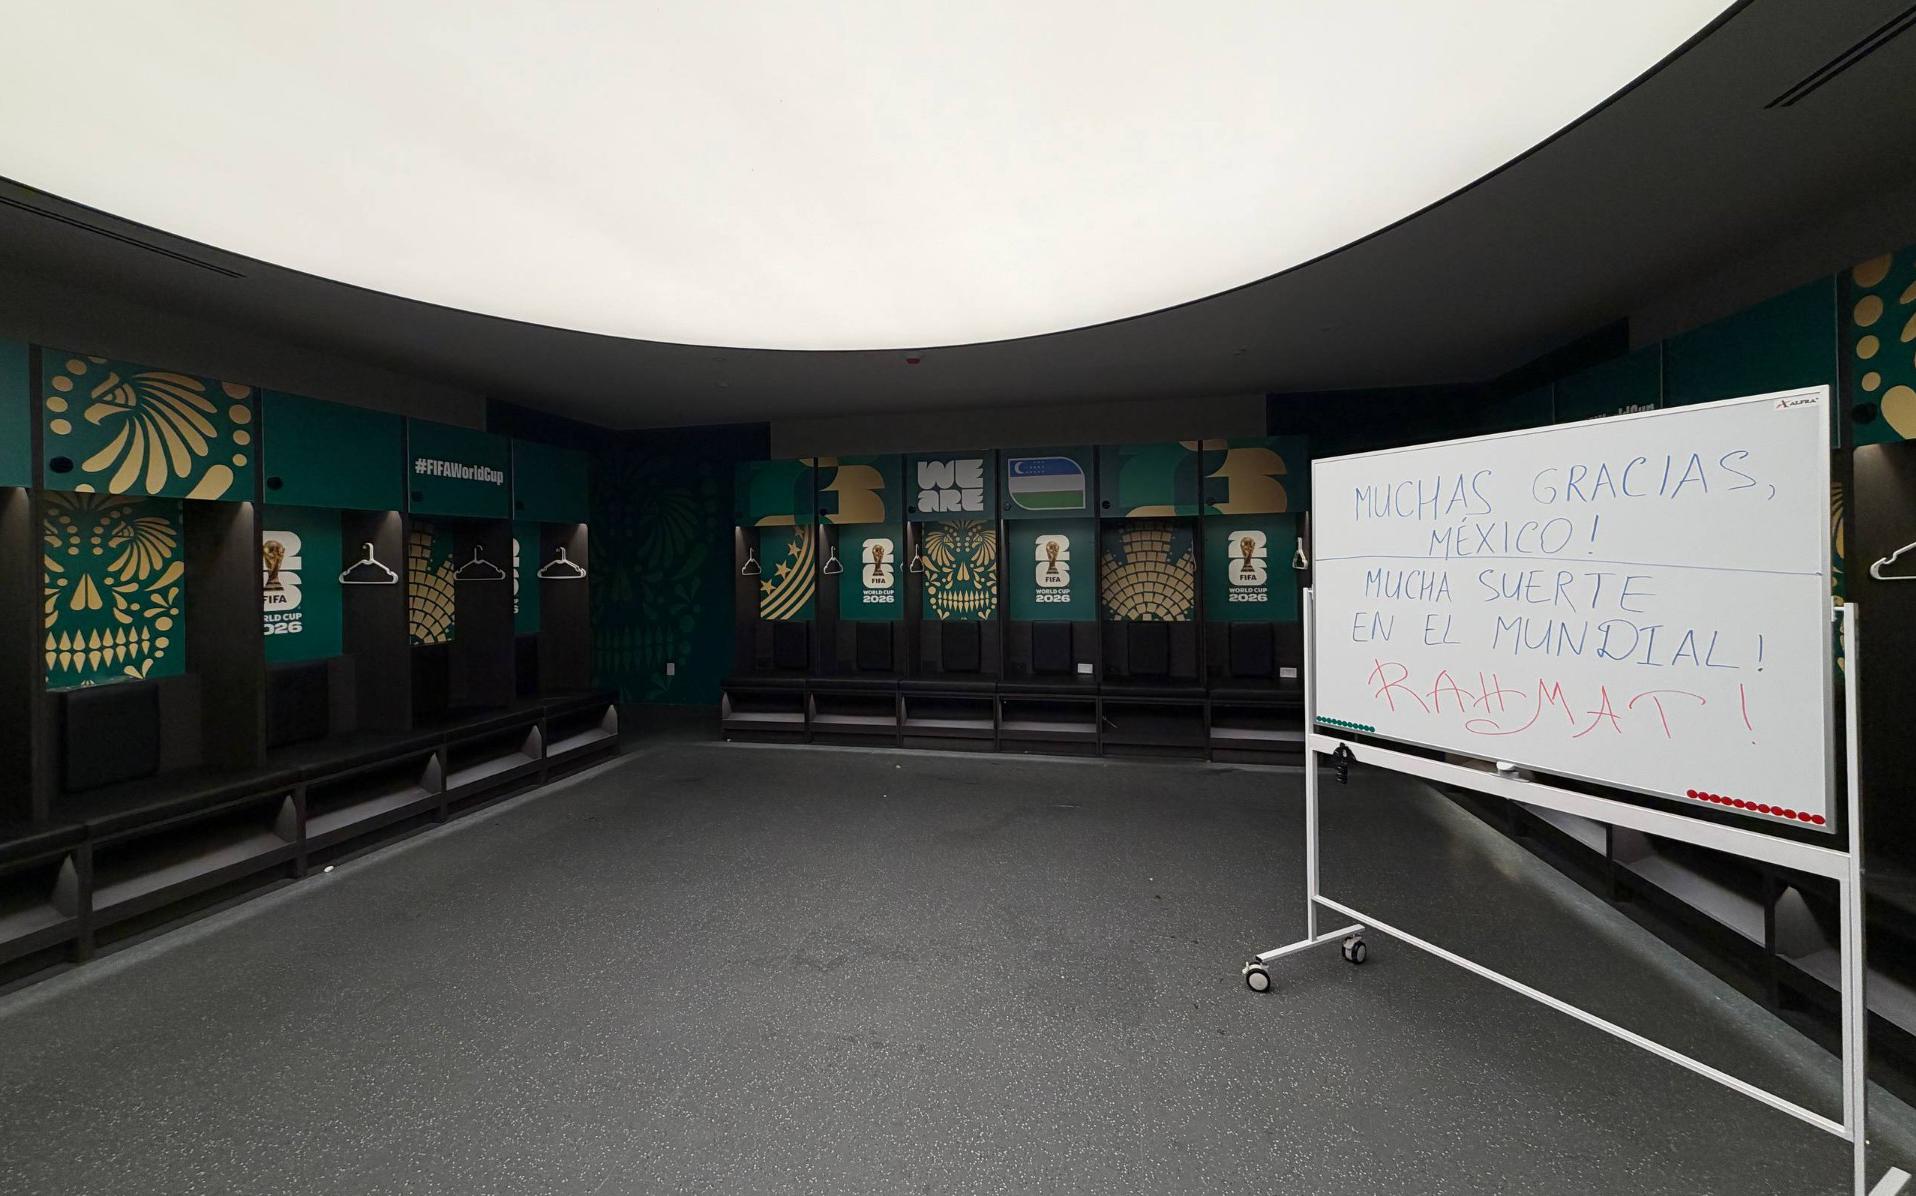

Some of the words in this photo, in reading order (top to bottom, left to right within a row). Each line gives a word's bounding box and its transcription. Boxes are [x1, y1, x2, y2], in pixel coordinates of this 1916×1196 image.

[415, 458, 504, 485] #FIFAWorldCup
[917, 459, 984, 490] WE
[1355, 469, 1492, 521] MUCHAS
[1532, 450, 1776, 504] GRACIAS,
[863, 595, 895, 603] 2026
[1035, 594, 1071, 603] 2026
[1228, 593, 1268, 602] 2026
[1365, 567, 1452, 602] MUCHA
[1478, 568, 1657, 613] SUERTE
[282, 612, 302, 620] CUP
[263, 621, 303, 635] 026
[1352, 610, 1394, 642] EN
[1424, 613, 1462, 646] EL
